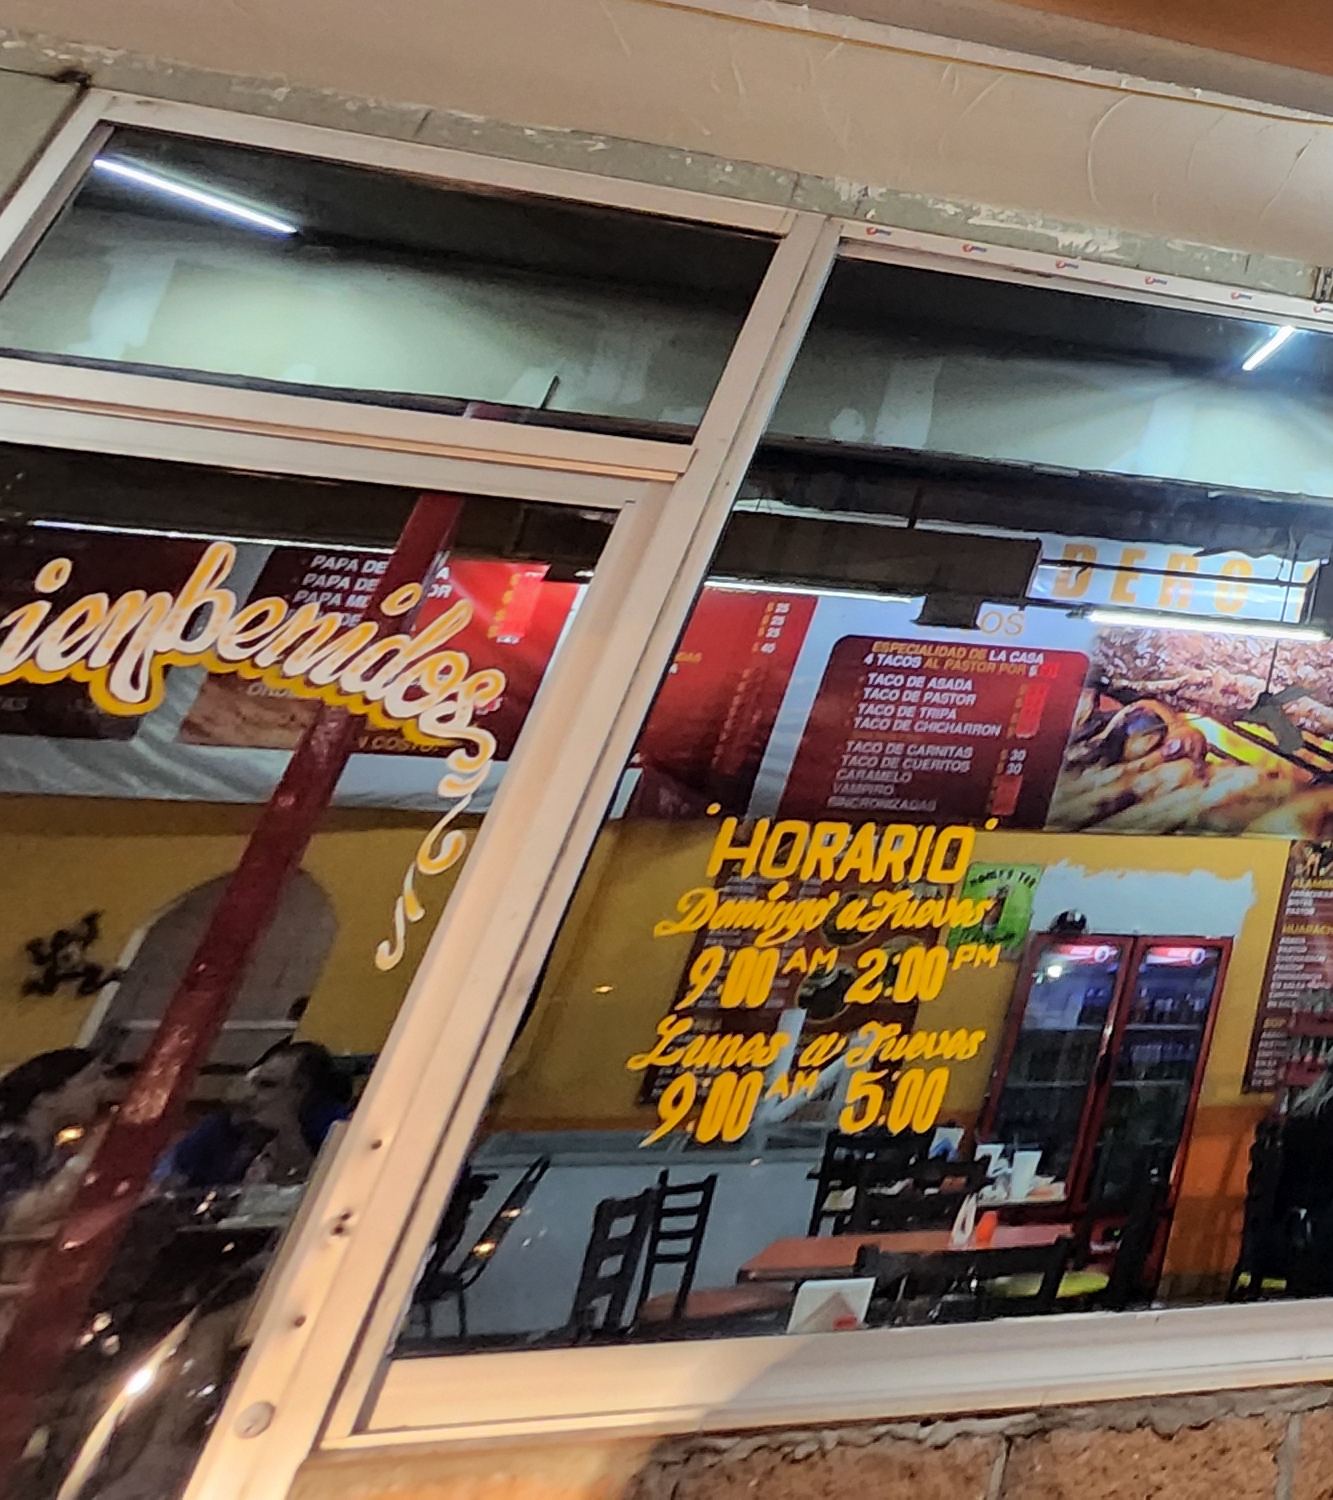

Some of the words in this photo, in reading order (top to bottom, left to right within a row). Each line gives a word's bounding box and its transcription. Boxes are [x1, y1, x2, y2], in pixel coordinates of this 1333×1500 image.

[310, 555, 359, 572] PAPA
[361, 559, 390, 574] DE
[302, 573, 351, 590] PAPA
[354, 578, 381, 592] DE
[1053, 543, 1253, 613] DERO
[293, 590, 341, 606] PAPA
[871, 641, 967, 658] ESPECIALIDAD
[969, 649, 988, 660] DE
[989, 650, 1006, 662] LA
[1009, 651, 1045, 664] CASA
[863, 653, 873, 664] 4
[877, 655, 922, 668] TACOS
[923, 660, 940, 670] AL
[944, 660, 997, 674] PASTOR
[999, 664, 1026, 675] POR
[867, 673, 904, 687] TACO
[906, 675, 924, 688] DE
[927, 677, 973, 691] ASADA
[863, 687, 900, 701] TACO
[902, 690, 920, 703] DE
[923, 692, 977, 707] PASTOR
[858, 703, 896, 717] TACO
[897, 706, 916, 719] DE
[919, 706, 957, 720] TRIPA
[853, 717, 890, 730] TACO
[892, 719, 911, 732] DE
[913, 721, 1002, 737] CHICHARRON
[845, 740, 883, 754] TACO
[885, 742, 903, 755] DE
[906, 744, 974, 758] CARNITAS
[840, 754, 878, 768] TACO
[880, 757, 898, 769] DE
[902, 758, 971, 773] CUERITOS
[835, 768, 913, 784] CARAMELO
[833, 783, 895, 796] VAMPIRO
[706, 816, 977, 885] HORARIO
[654, 880, 838, 948] Domingo
[856, 890, 995, 933] Jueves
[674, 945, 780, 1011] 9:00
[782, 946, 840, 975] AM
[844, 945, 950, 1005] 2:00
[951, 943, 1001, 970] PM
[626, 1014, 791, 1071] Lunes
[846, 1020, 987, 1069] Jueves
[638, 1070, 765, 1148] 9:00
[764, 1069, 821, 1101] AM
[839, 1066, 950, 1137] 5:00
